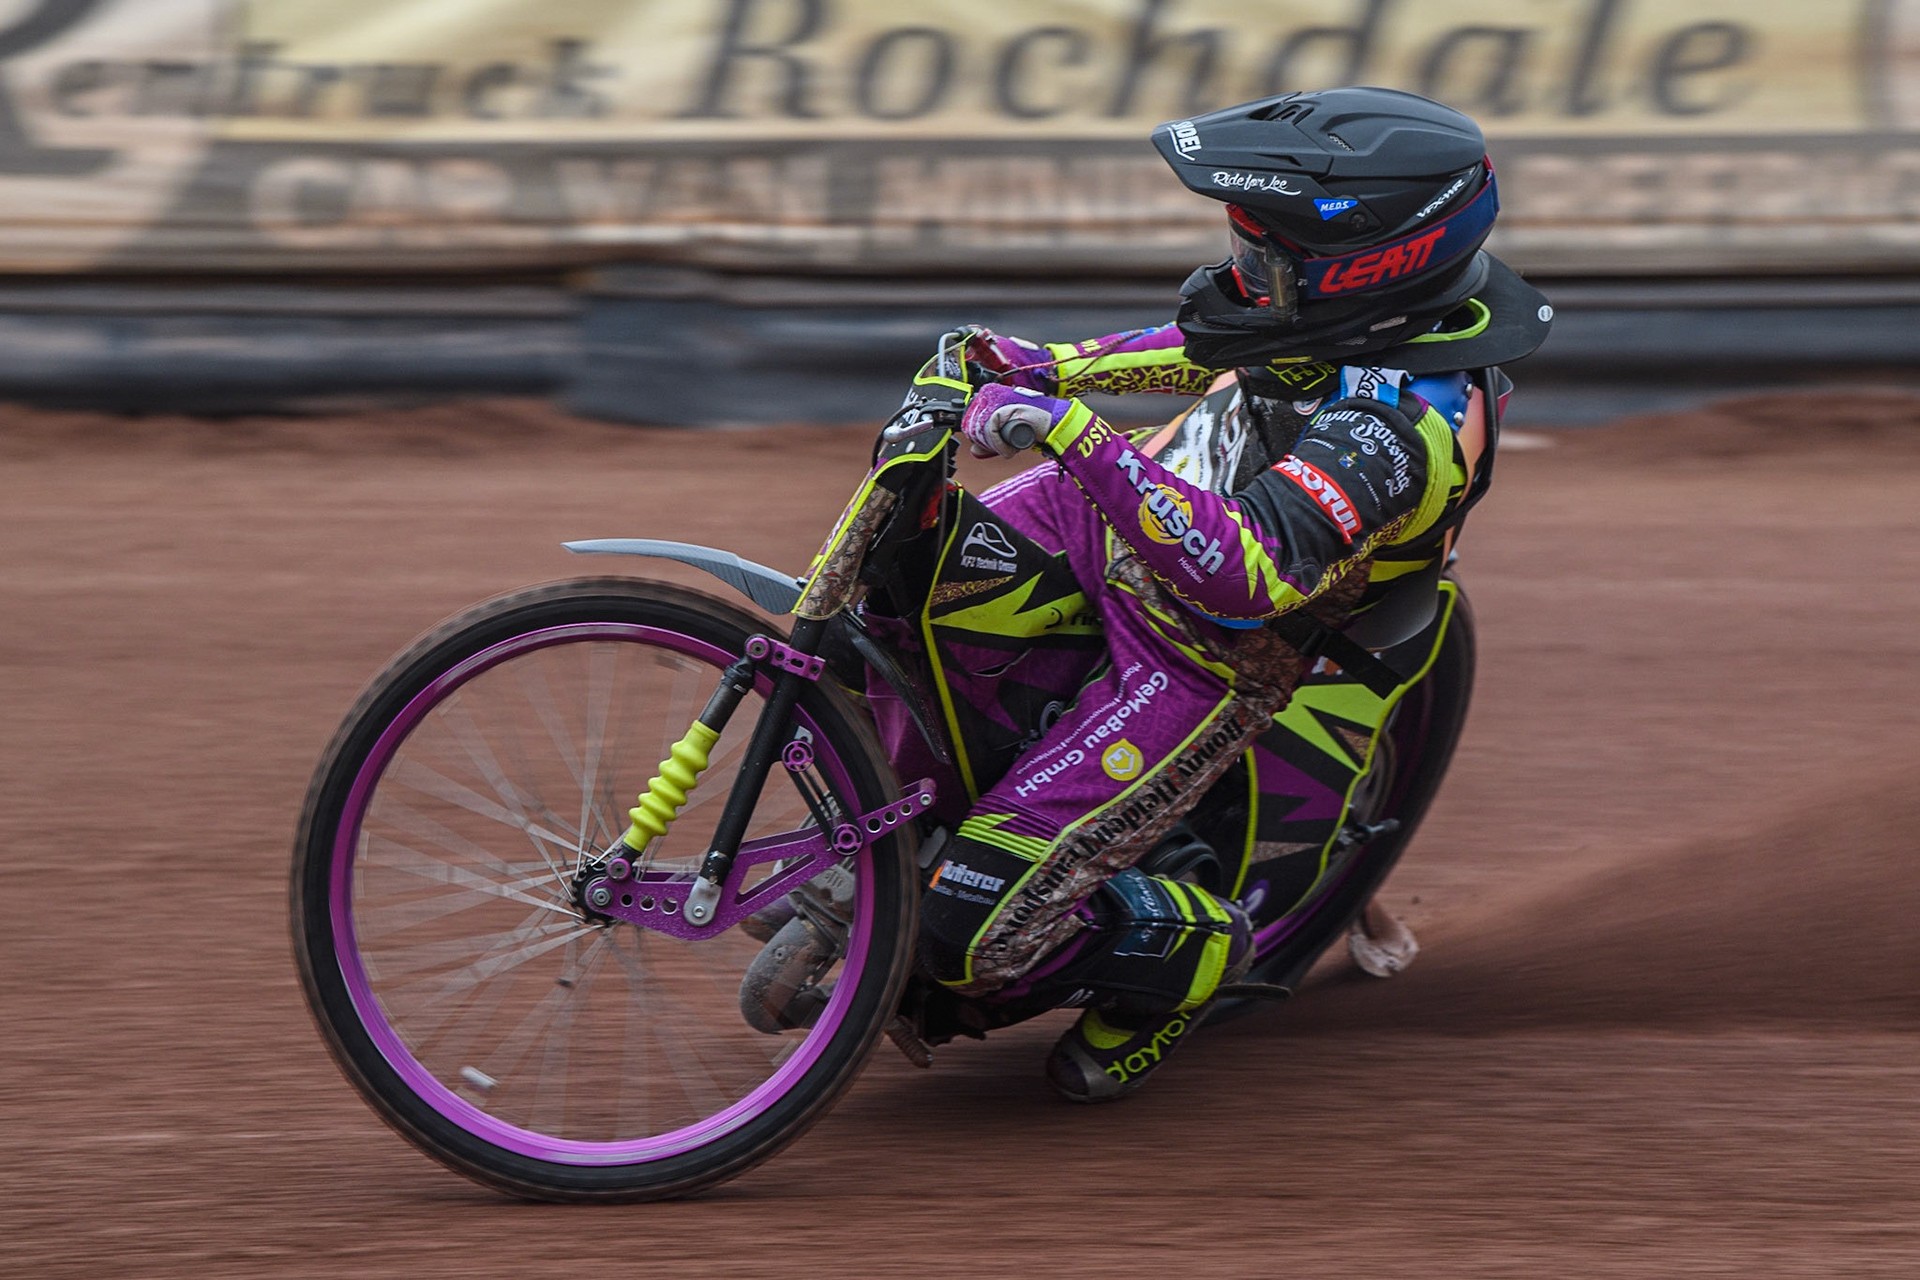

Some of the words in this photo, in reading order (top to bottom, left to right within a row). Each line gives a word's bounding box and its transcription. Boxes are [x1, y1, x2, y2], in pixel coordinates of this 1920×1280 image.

[680, 0, 1754, 122] Rochdale
[1212, 171, 1244, 187] Ride
[1243, 173, 1267, 191] for
[1261, 175, 1302, 196] Lee
[1319, 226, 1447, 293] LEATT
[1077, 416, 1112, 459] isa
[1116, 449, 1226, 577] Krusch
[1083, 671, 1169, 749] GeMoBau
[1014, 749, 1086, 798] GmbH
